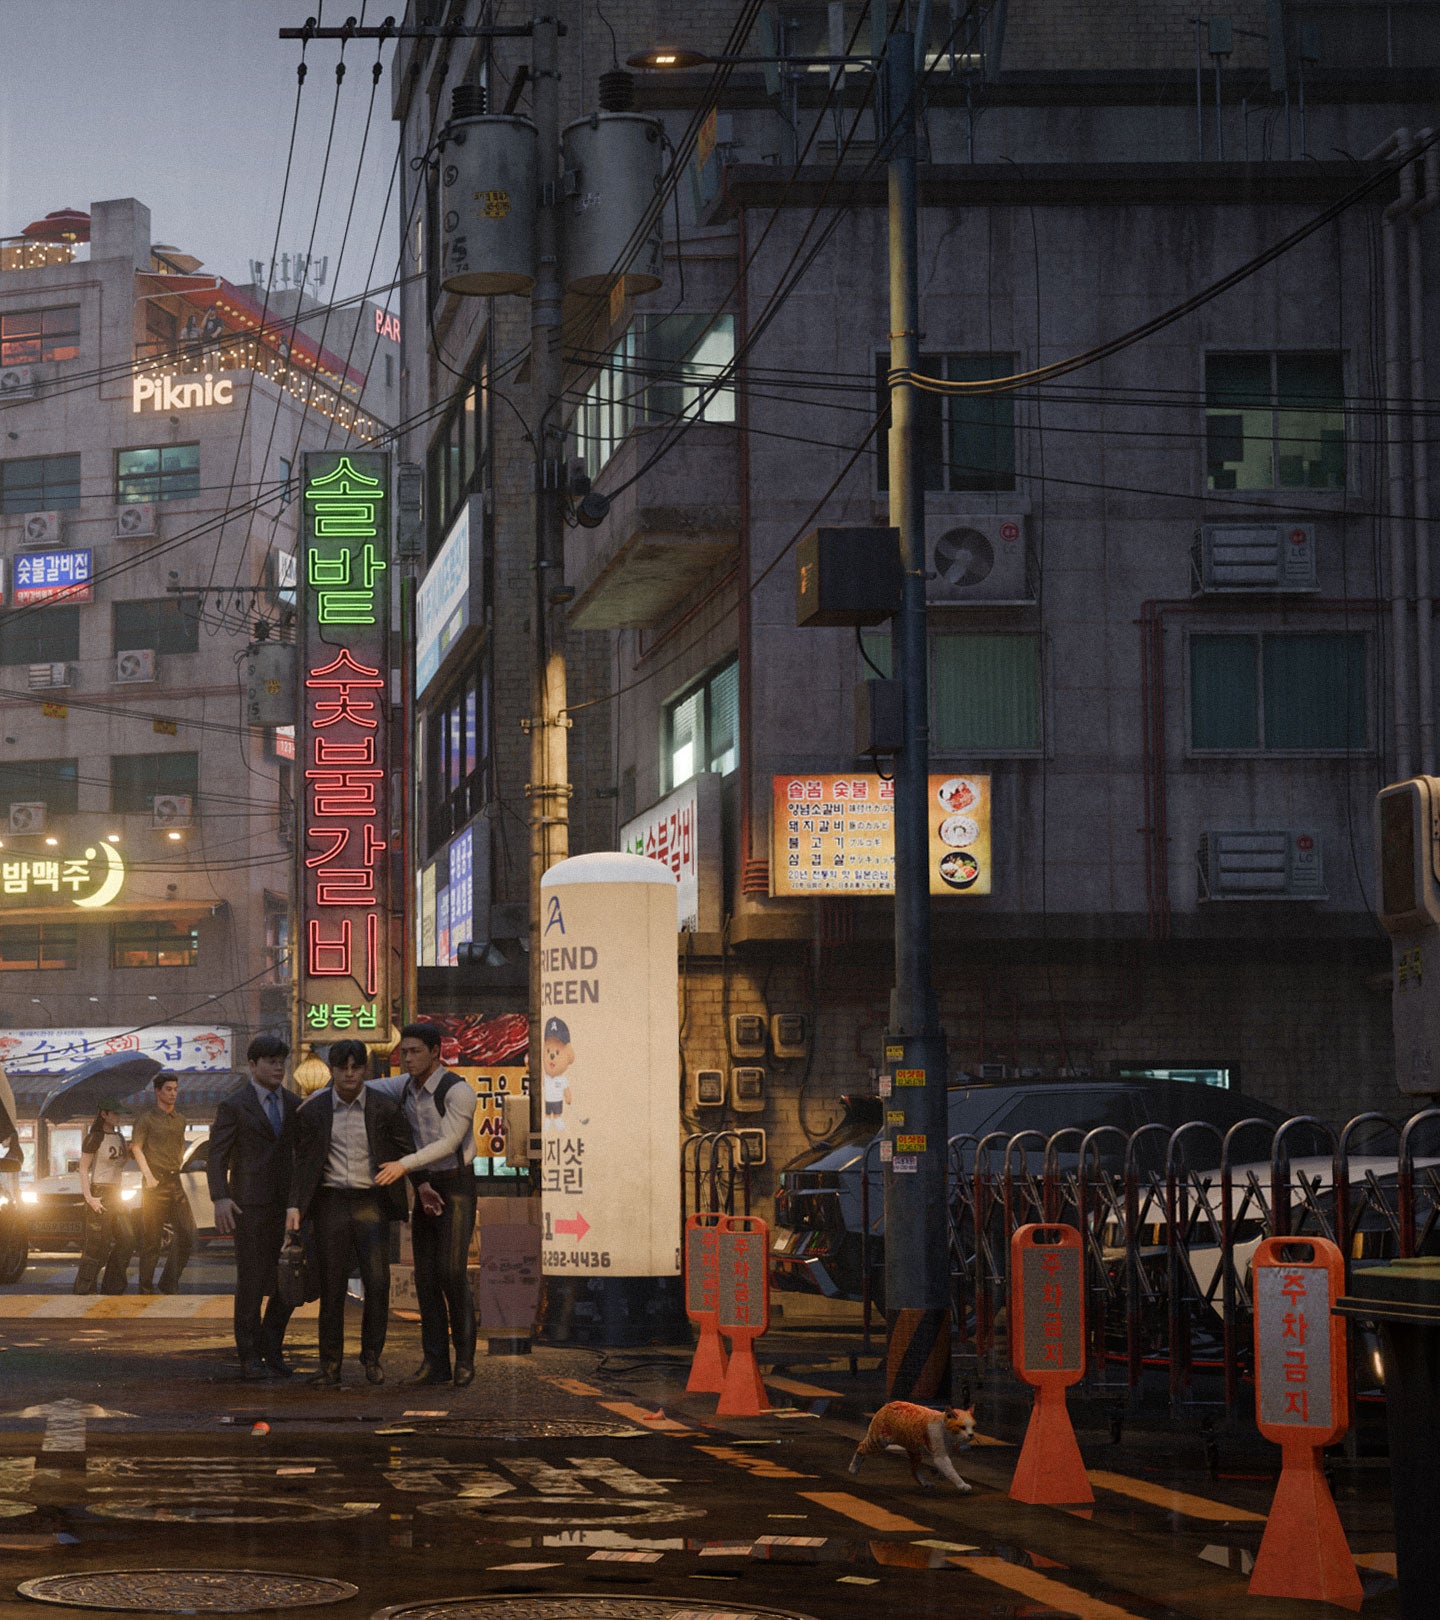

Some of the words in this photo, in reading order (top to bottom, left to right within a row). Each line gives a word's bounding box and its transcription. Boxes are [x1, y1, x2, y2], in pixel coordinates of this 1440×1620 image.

[375, 310, 401, 344] BAR
[132, 374, 233, 414] Piknic
[306, 457, 386, 623] 솔밭
[17, 553, 89, 585] 숯불갈비집
[305, 648, 386, 996] 숯불갈비
[541, 946, 598, 972] RIEND
[541, 980, 599, 1006] REEN
[307, 1003, 378, 1029] 생등심
[544, 1138, 584, 1166] 지샷
[542, 1167, 583, 1194] 크린
[734, 1238, 750, 1325] 주차금지
[1042, 1252, 1063, 1369] 주차금지
[1281, 1274, 1309, 1423] 주차금지
